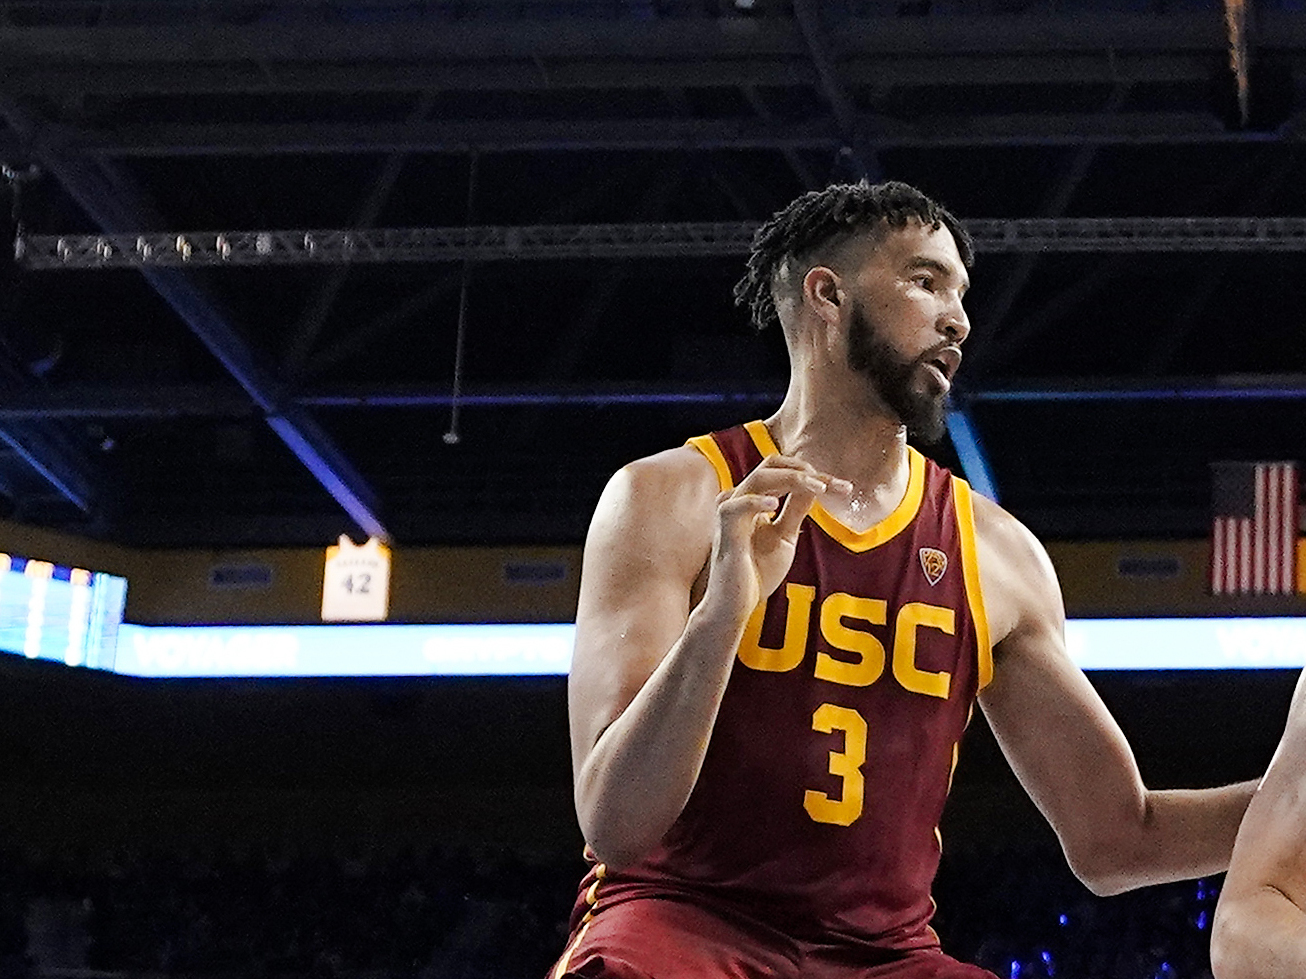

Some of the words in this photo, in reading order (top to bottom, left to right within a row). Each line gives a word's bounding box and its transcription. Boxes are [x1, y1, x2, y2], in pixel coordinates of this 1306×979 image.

[341, 574, 371, 594] 42
[132, 633, 299, 669] VOYAGER
[738, 583, 956, 699] USC
[803, 703, 868, 827] 3
